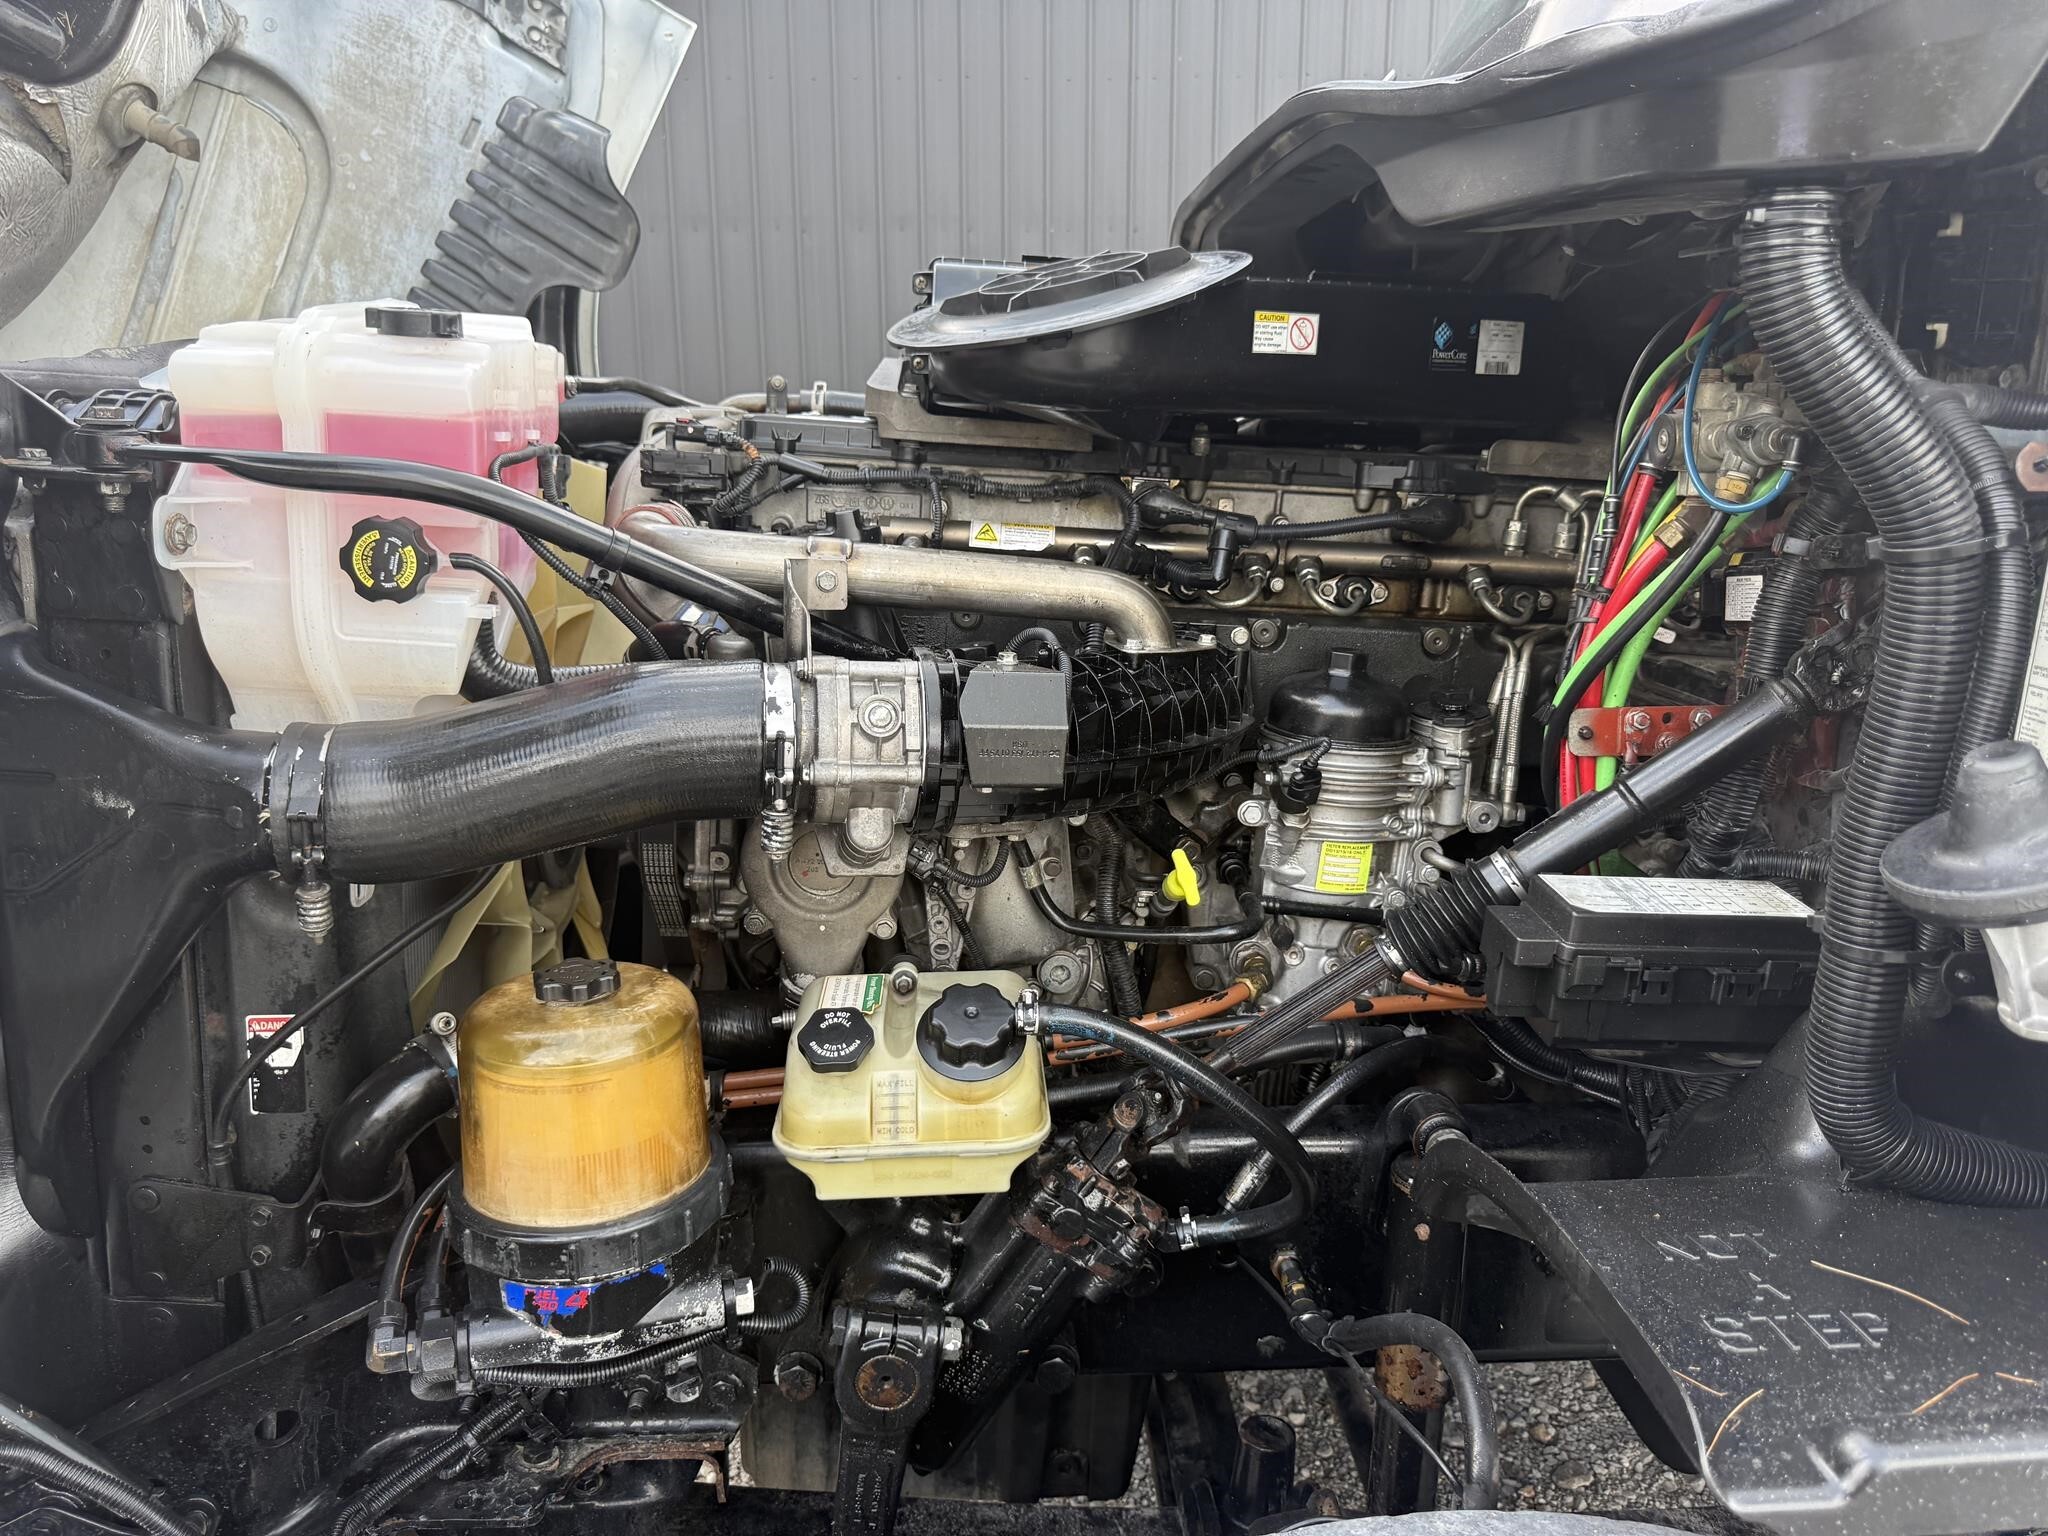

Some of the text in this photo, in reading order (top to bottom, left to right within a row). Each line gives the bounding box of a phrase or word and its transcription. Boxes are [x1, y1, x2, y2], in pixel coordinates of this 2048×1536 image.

[1432, 348, 1467, 360] PowerCore
[354, 533, 374, 585] AVERTISSEMENT
[400, 554, 415, 585] CAUTION
[820, 1017, 852, 1028] OVERFILL
[809, 1039, 861, 1057] POWER STEERING
[823, 1042, 847, 1050] FLUID
[1642, 1233, 1777, 1262] NOT
[1700, 1311, 1888, 1352] STEP
